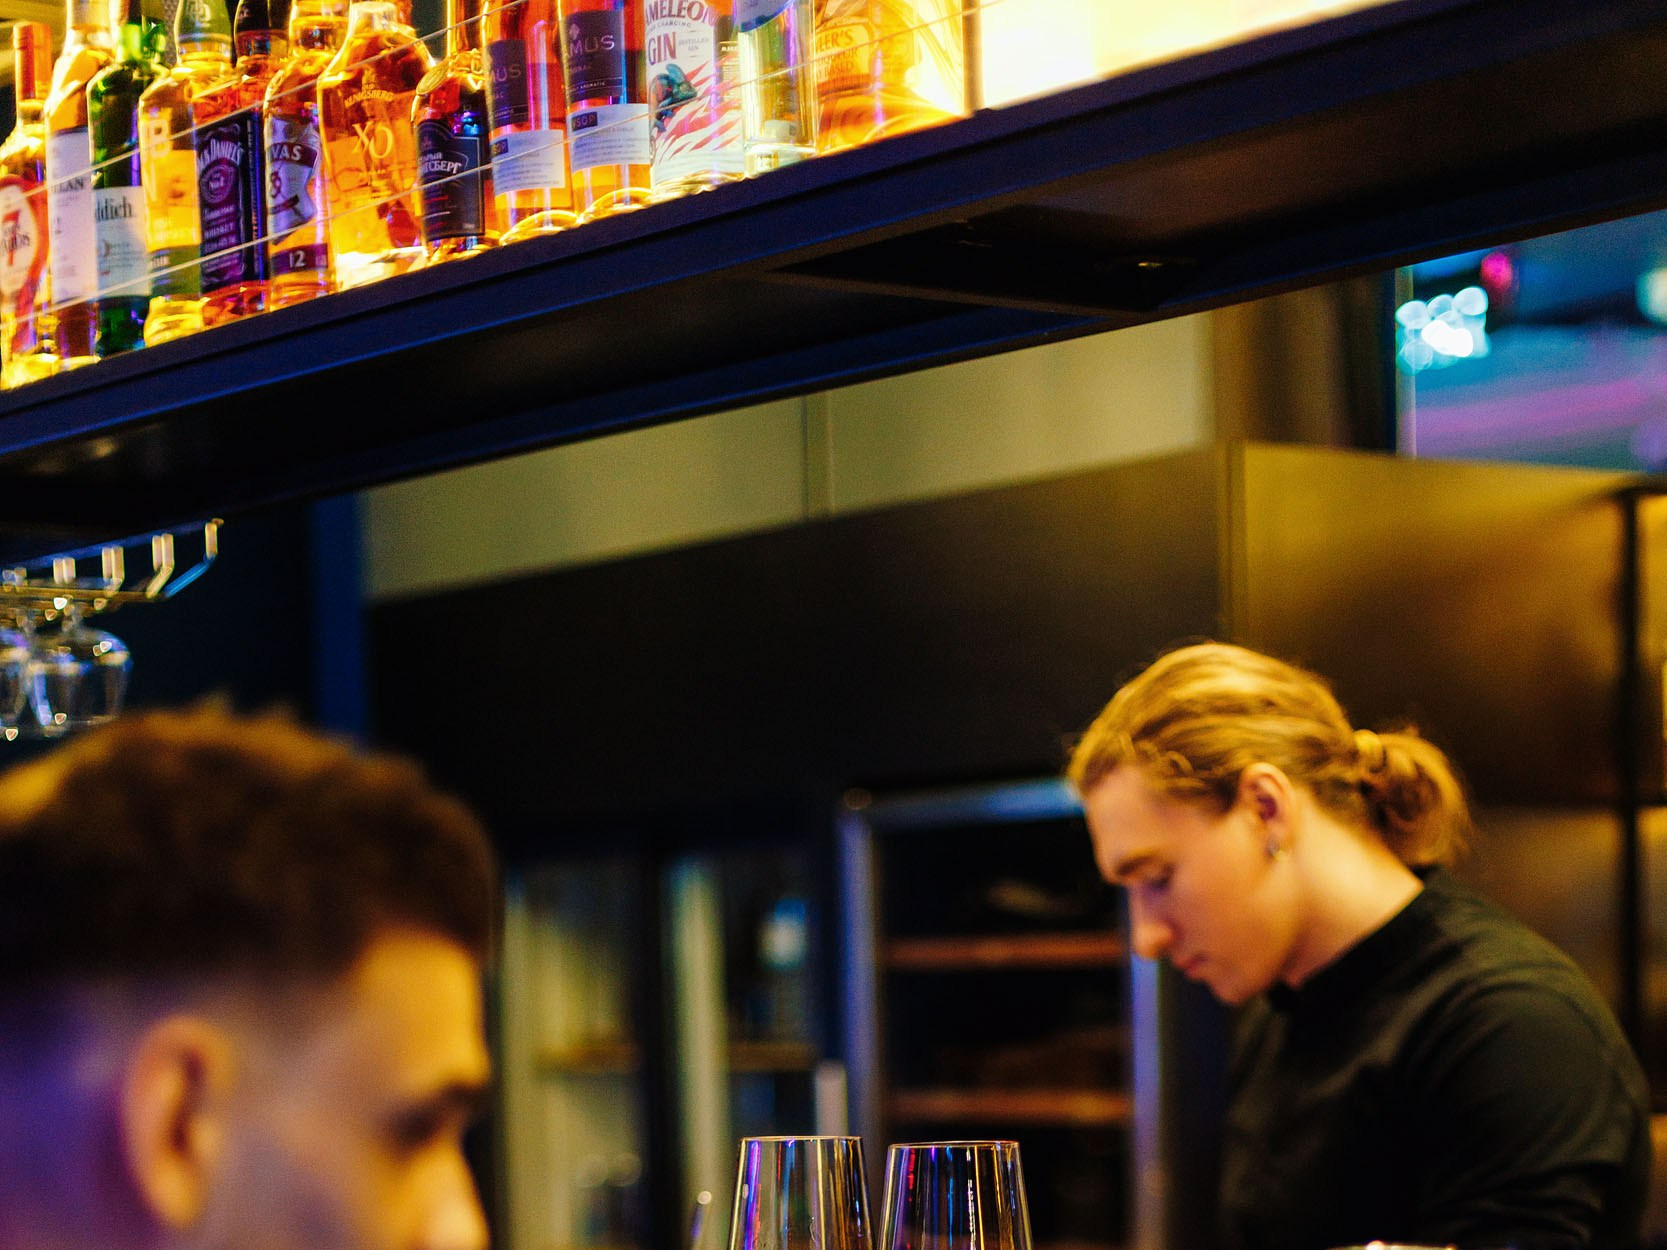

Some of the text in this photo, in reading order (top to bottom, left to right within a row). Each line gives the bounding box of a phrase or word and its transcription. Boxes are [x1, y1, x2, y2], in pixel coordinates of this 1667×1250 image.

[648, 32, 677, 65] GIN
[351, 121, 394, 159] XO
[289, 250, 306, 269] 12
